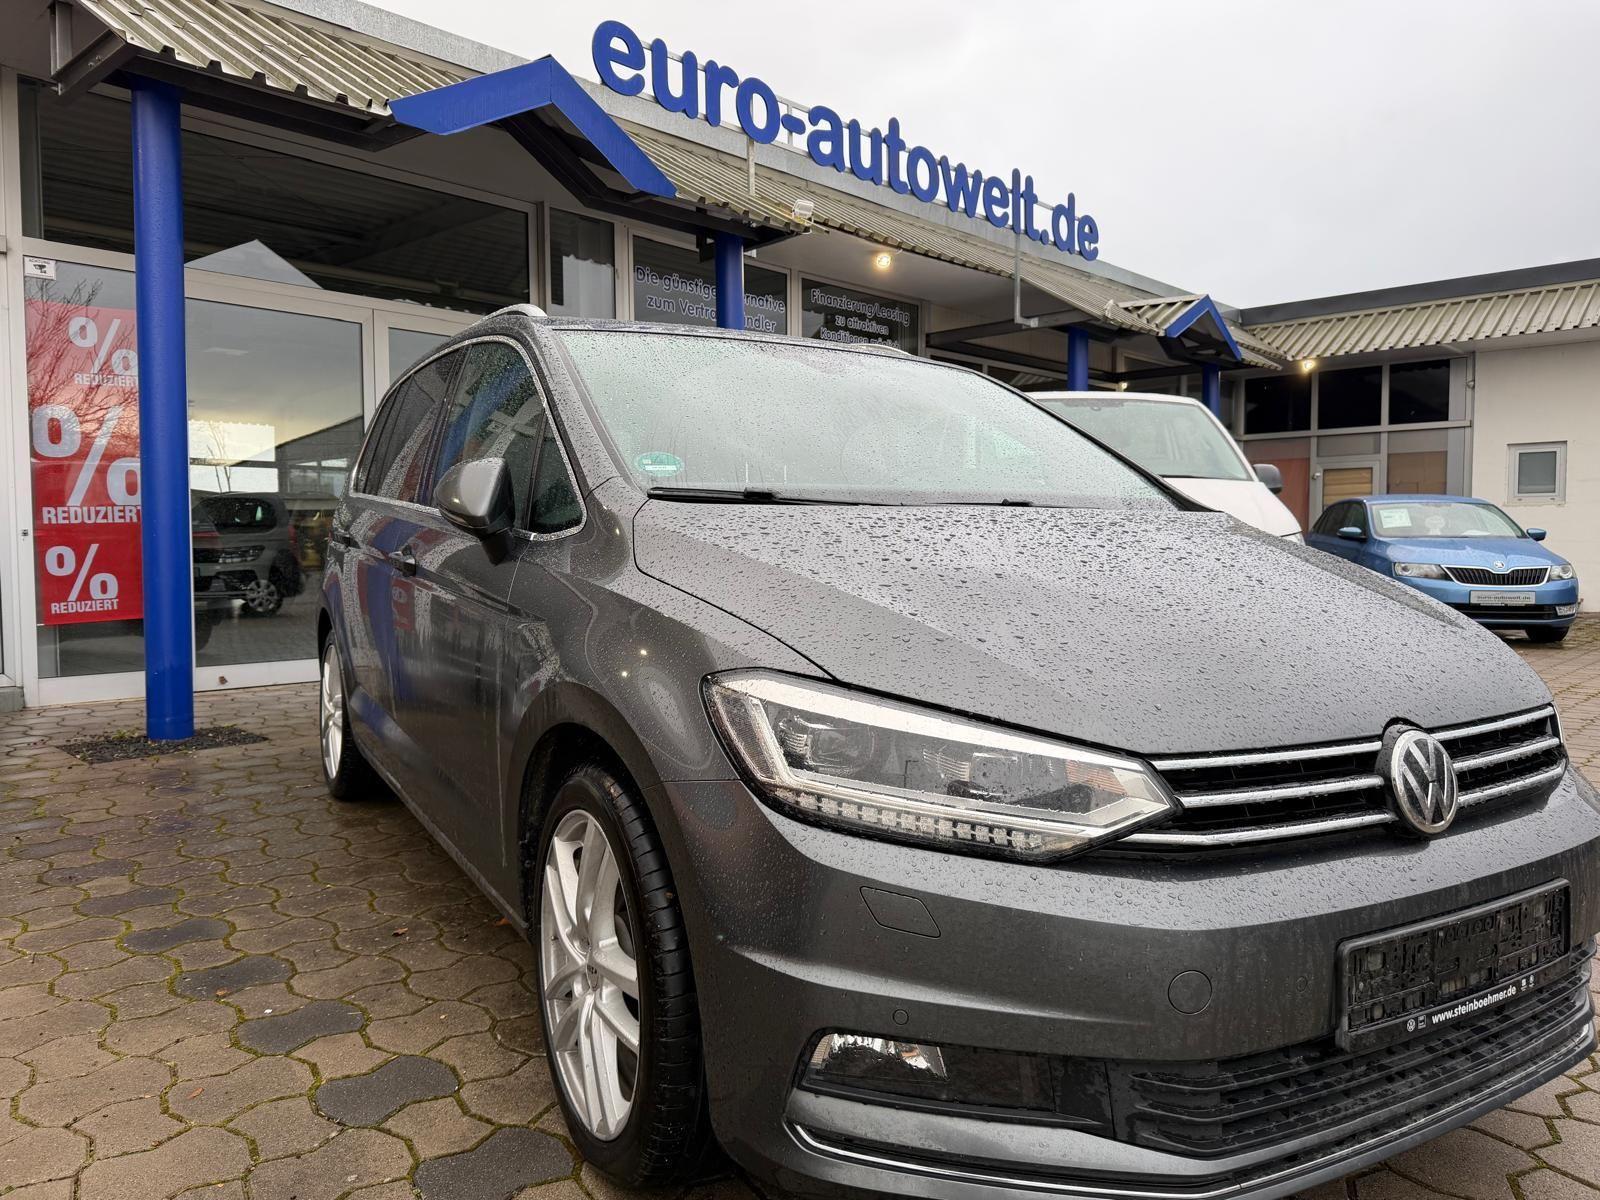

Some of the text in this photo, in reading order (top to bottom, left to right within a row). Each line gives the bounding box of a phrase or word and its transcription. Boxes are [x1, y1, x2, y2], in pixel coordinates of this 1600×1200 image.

[592, 20, 1099, 261] euro-autowelt.de
[635, 265, 785, 313] Die günstige rnative
[647, 296, 675, 313] zum
[811, 288, 910, 327] Finanzierung/Leasing
[820, 326, 870, 345] Konditionen
[835, 314, 889, 336] zu attraktiven
[74, 372, 138, 387] REDUZIER
[45, 543, 119, 601] %
[50, 599, 120, 615] REDUZIERT
[1431, 985, 1517, 1025] www.steinboehmer.de
